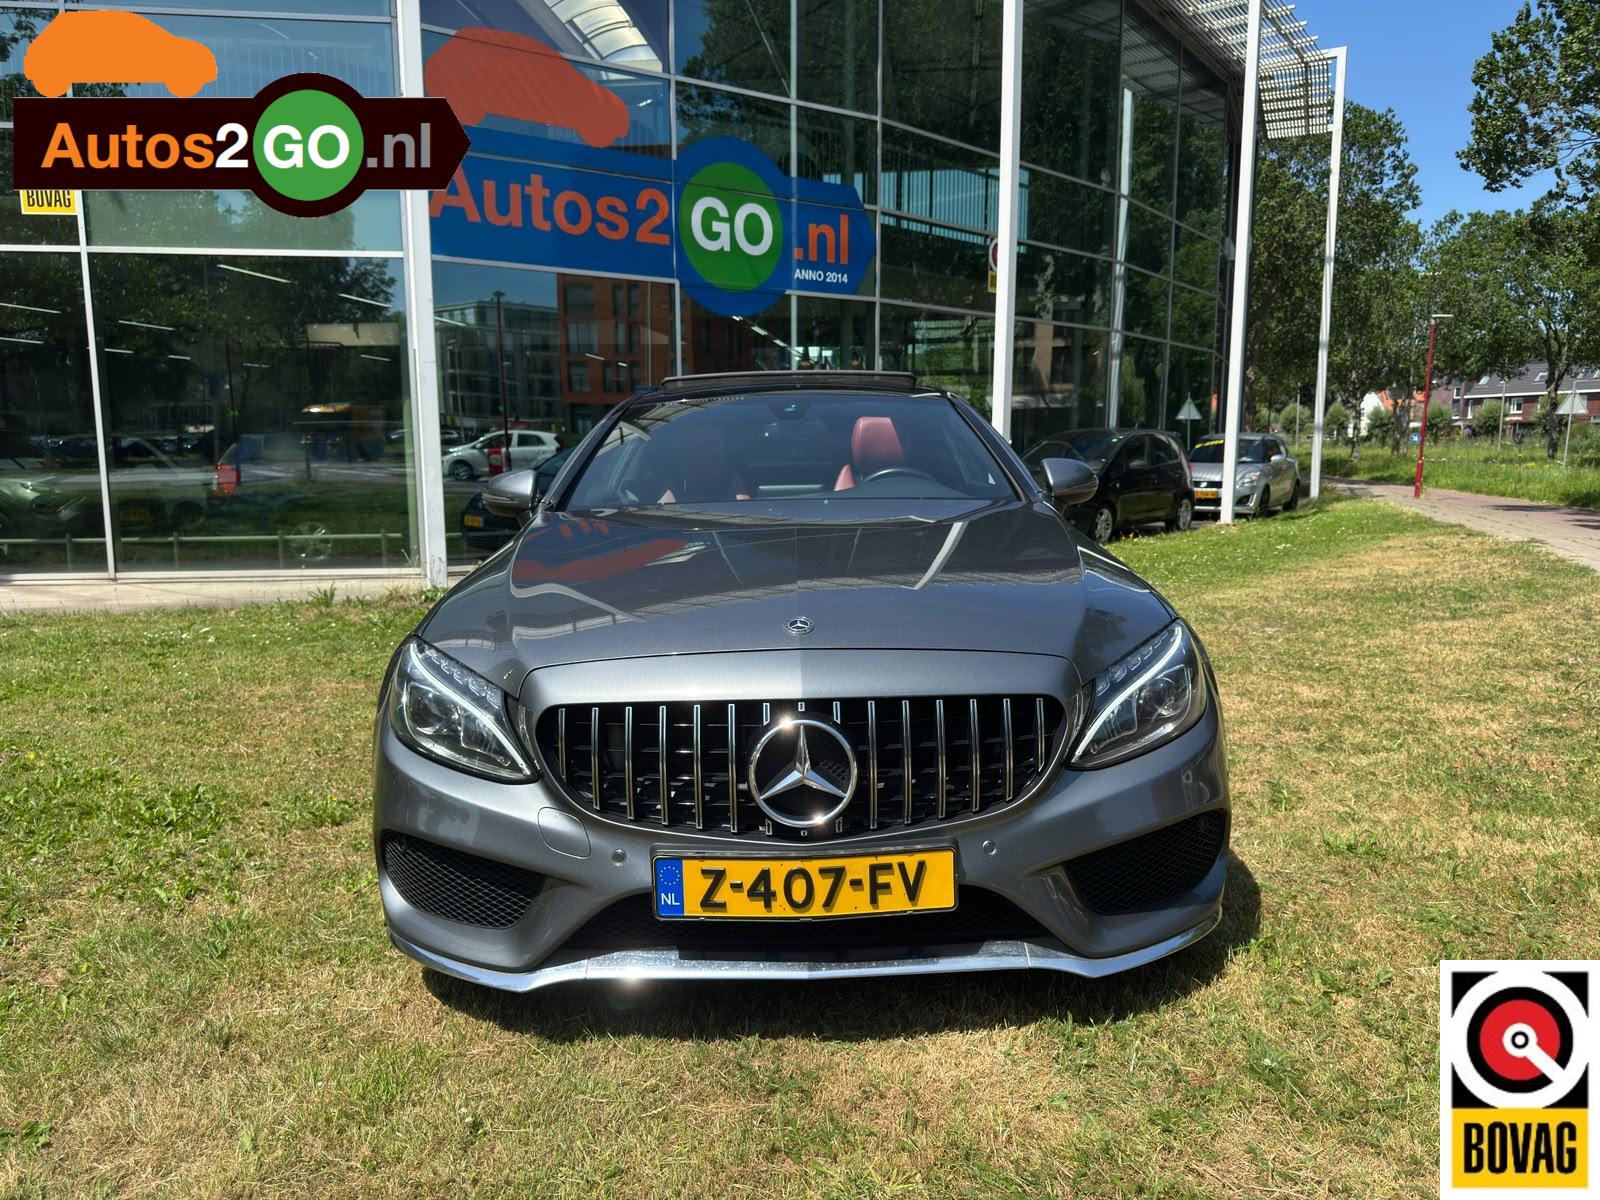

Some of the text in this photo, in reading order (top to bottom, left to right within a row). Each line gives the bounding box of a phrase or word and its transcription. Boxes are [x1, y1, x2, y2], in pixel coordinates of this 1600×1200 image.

[26, 190, 71, 207] BOVAG
[429, 164, 849, 265] Autos2GO.nl
[794, 268, 848, 283] ANNO 2014
[700, 859, 928, 910] Z-407-FV
[661, 892, 680, 905] NL
